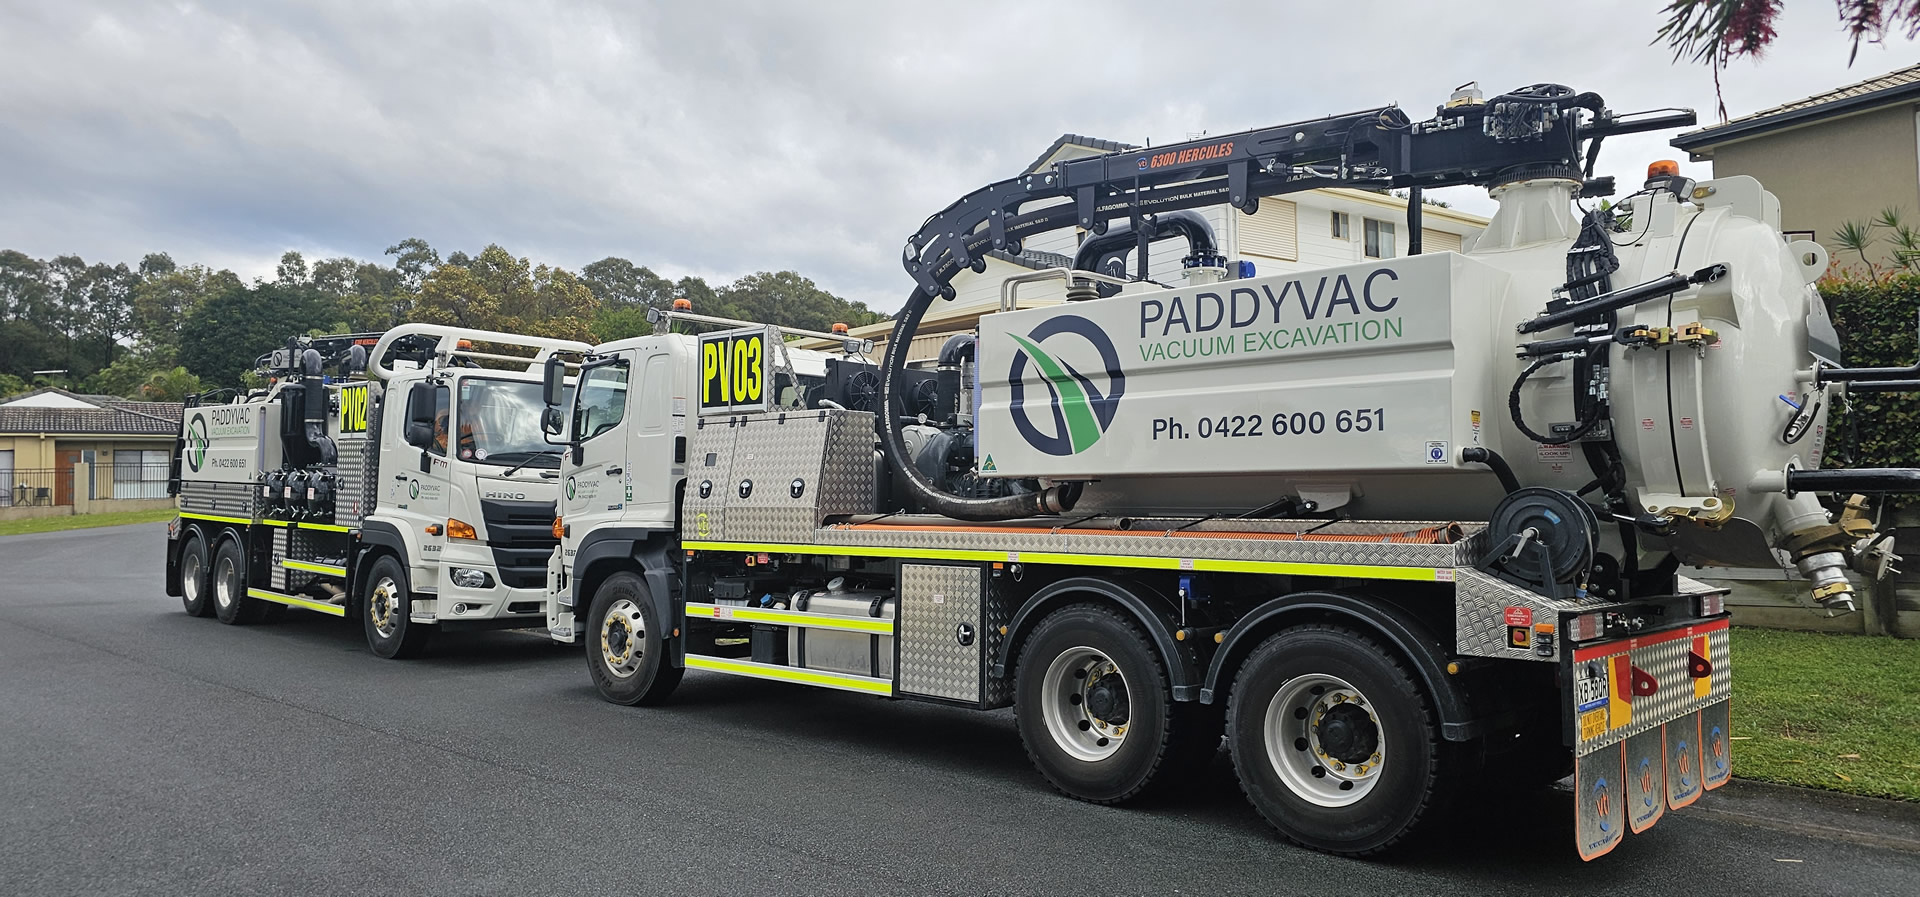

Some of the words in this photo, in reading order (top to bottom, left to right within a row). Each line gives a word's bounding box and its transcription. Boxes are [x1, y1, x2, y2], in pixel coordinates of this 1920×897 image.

[1151, 152, 1177, 169] 6300
[1177, 142, 1234, 164] HERCULES
[1179, 192, 1193, 200] BULK
[1193, 187, 1218, 197] MATERIAL
[1140, 268, 1400, 339] PADDYVAC
[1139, 334, 1235, 362] VACUUM
[1243, 316, 1403, 353] EXCAVATION
[886, 355, 895, 387] EVOLUTION
[895, 323, 906, 344] MATERIAL
[703, 336, 762, 404] PV03
[211, 407, 251, 426] PADDYVAC
[341, 386, 368, 431] PV02
[211, 426, 227, 436] VACUUM
[227, 425, 250, 435] EXCAVATION
[1152, 417, 1190, 441] Ph.
[1197, 414, 1263, 439] 0422
[1271, 411, 1326, 436] 600
[1335, 407, 1385, 433] 651
[218, 458, 229, 468] 0422
[229, 458, 239, 468] 600
[239, 458, 247, 468] 651
[433, 458, 448, 469] FM
[421, 484, 441, 492] PADDYVAC
[577, 480, 600, 488] PADDYVAC
[485, 491, 526, 500] HINO
[423, 544, 442, 552] 2632
